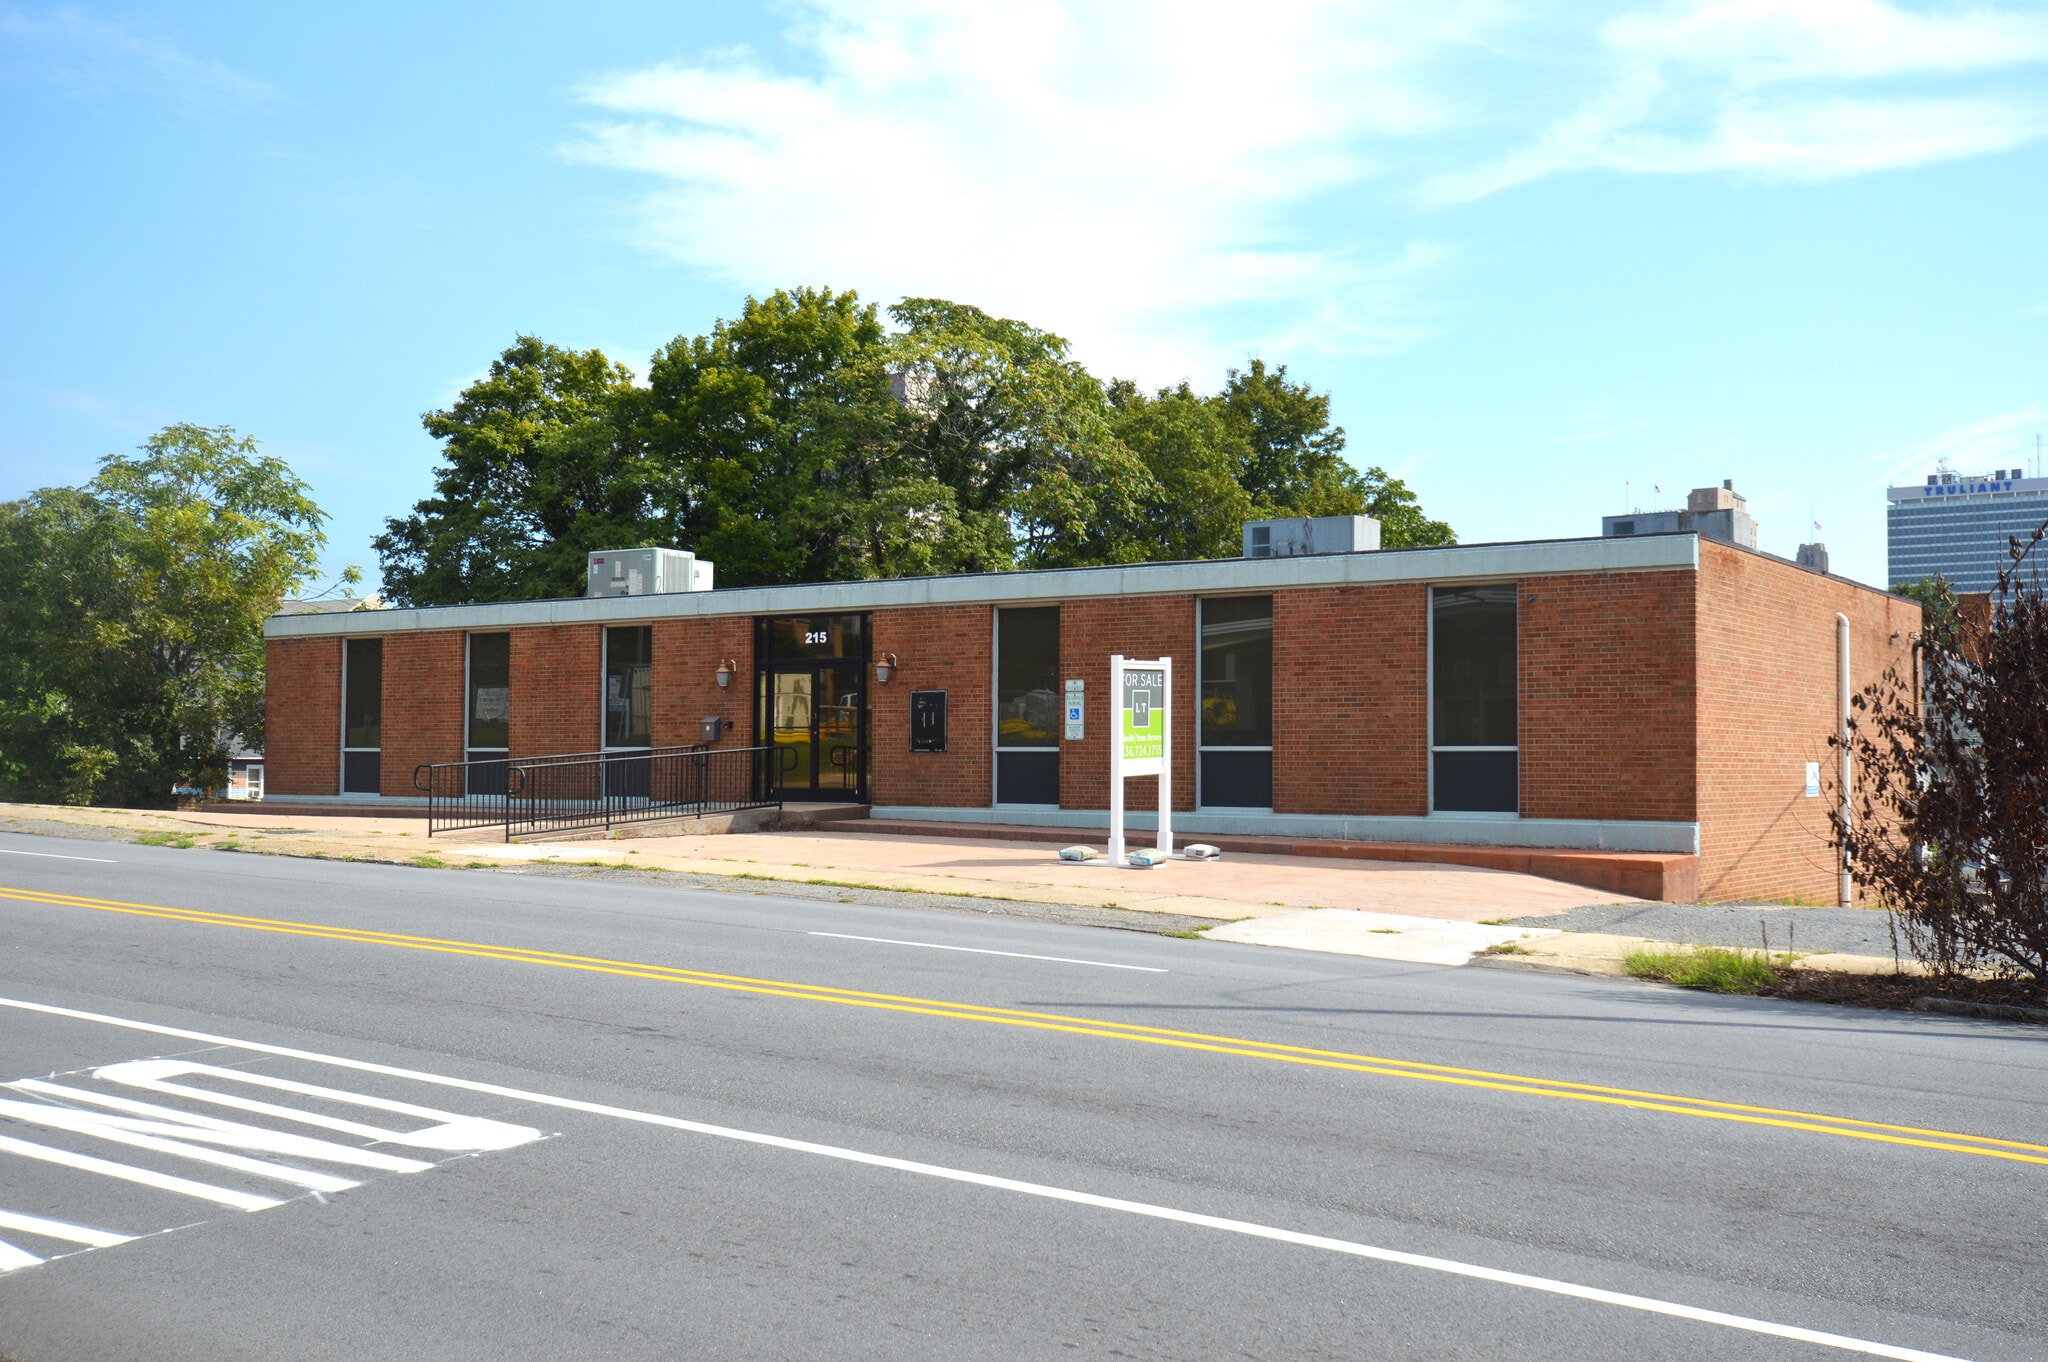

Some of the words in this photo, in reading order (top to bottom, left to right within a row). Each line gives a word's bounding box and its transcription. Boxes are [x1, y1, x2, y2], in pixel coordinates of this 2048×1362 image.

[1924, 481, 2012, 496] TRULIANT
[805, 631, 827, 644] 215
[1140, 674, 1163, 687] SALE
[1123, 744, 1163, 757] 36.724.1715
